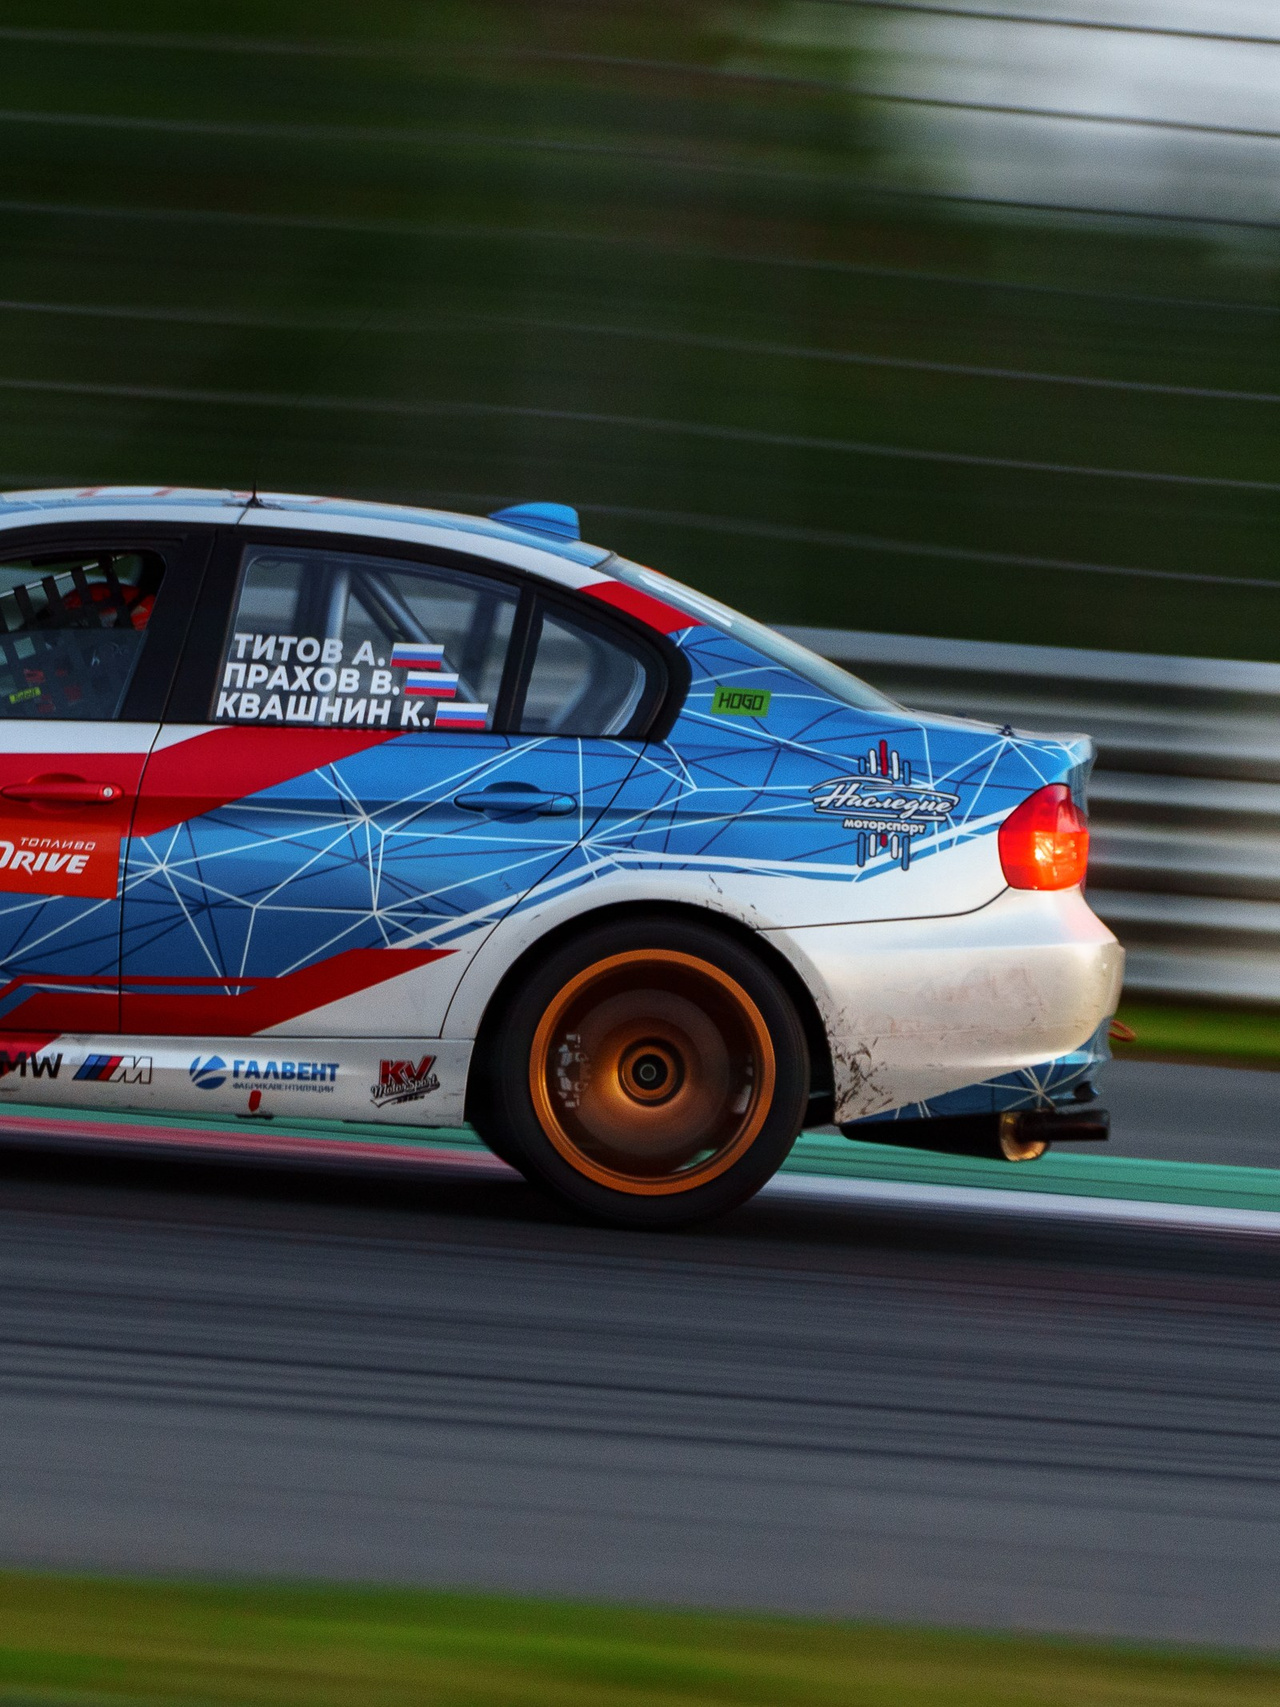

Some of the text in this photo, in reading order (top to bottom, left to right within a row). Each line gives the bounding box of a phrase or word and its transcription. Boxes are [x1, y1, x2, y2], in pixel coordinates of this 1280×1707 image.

[234, 633, 386, 667] ТИТОВ А.
[223, 662, 400, 696] ПРАХОВ В.
[216, 692, 430, 727] КВАШНИН К.
[718, 692, 764, 711] HOGO
[813, 782, 955, 820] Наследие
[20, 837, 96, 850] ТОПЛИВО
[843, 819, 926, 836] моторспорт
[233, 1060, 340, 1082] ГАЛВЕНТ
[379, 1054, 437, 1087] KV
